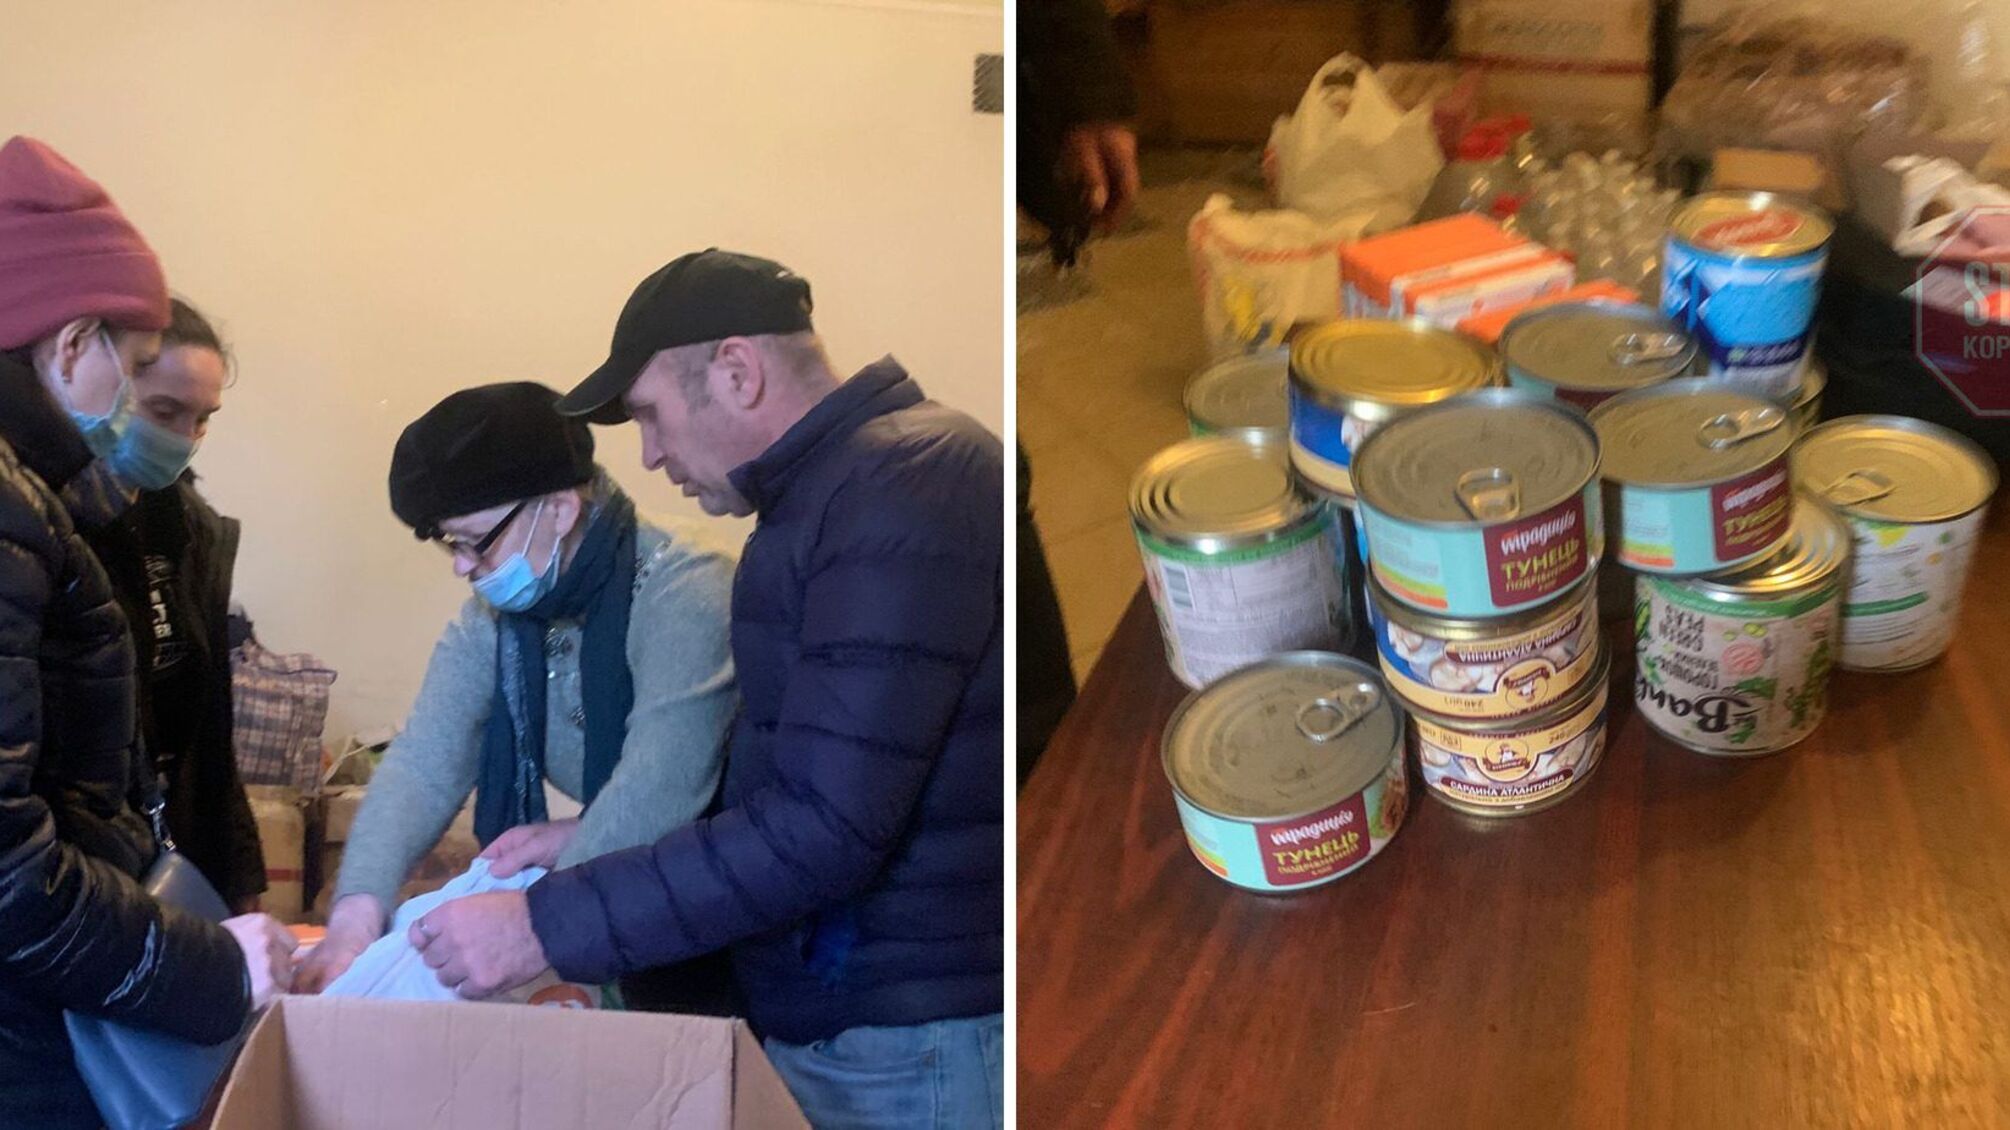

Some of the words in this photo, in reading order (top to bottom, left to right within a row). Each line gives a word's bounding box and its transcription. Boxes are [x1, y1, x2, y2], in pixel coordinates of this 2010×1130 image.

[1501, 537, 1580, 581] ТУНЕЦЬ
[1450, 780, 1497, 796] САРДИНА
[1272, 830, 1360, 866] ТУНЕЦЬ
